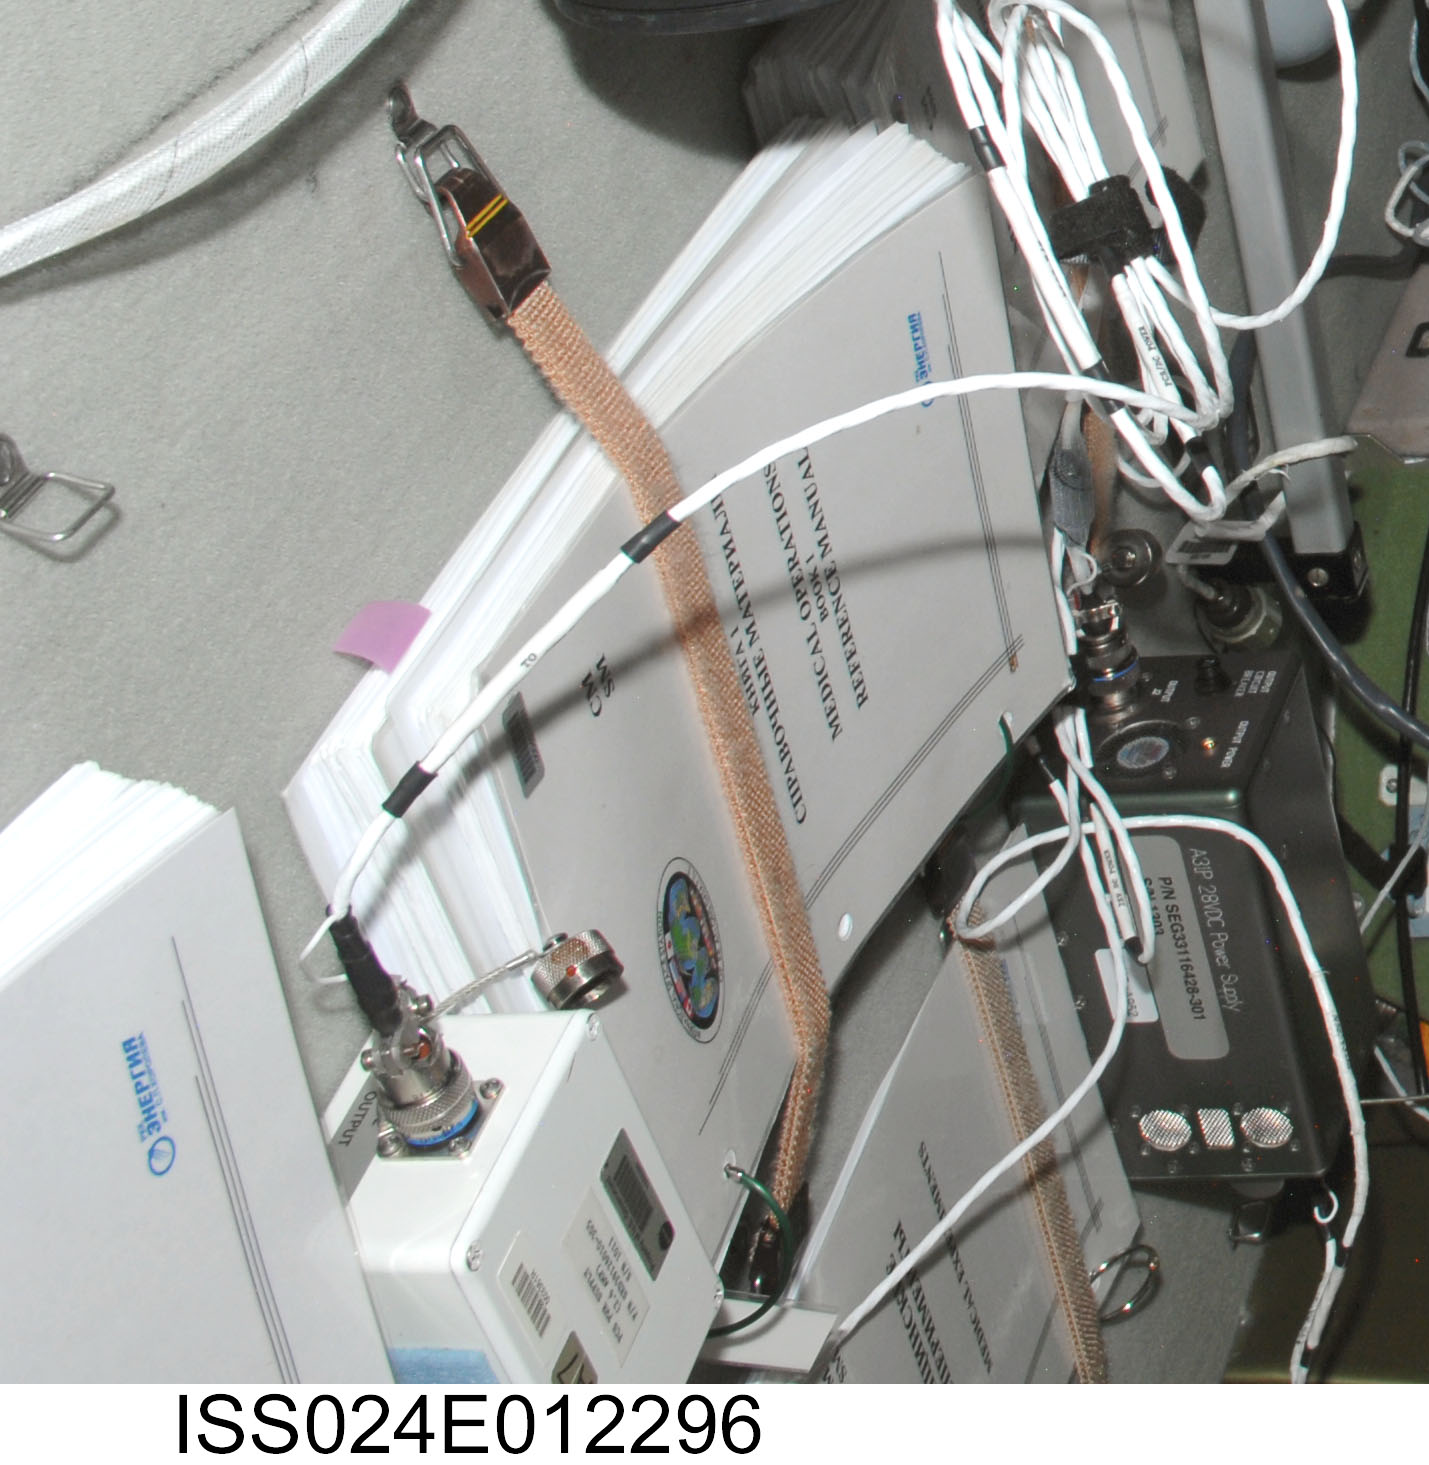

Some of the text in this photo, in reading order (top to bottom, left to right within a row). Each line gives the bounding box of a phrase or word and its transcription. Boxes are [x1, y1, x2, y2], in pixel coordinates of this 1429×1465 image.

[762, 462, 845, 742] MEDICAL OPERATIONS
[797, 446, 867, 710] REFERENCE MANUAL
[807, 567, 832, 622] BOOK
[594, 653, 617, 697] SM
[750, 647, 810, 825] СПРАВОЧНЫЕ
[1158, 876, 1207, 1022] P/N SEG33116428-301
[1209, 929, 1235, 969] Power
[1215, 971, 1246, 1016] Supply
[121, 1036, 163, 1137] ЭНЕРГИЯ
[340, 1089, 379, 1148] OUTPUT
